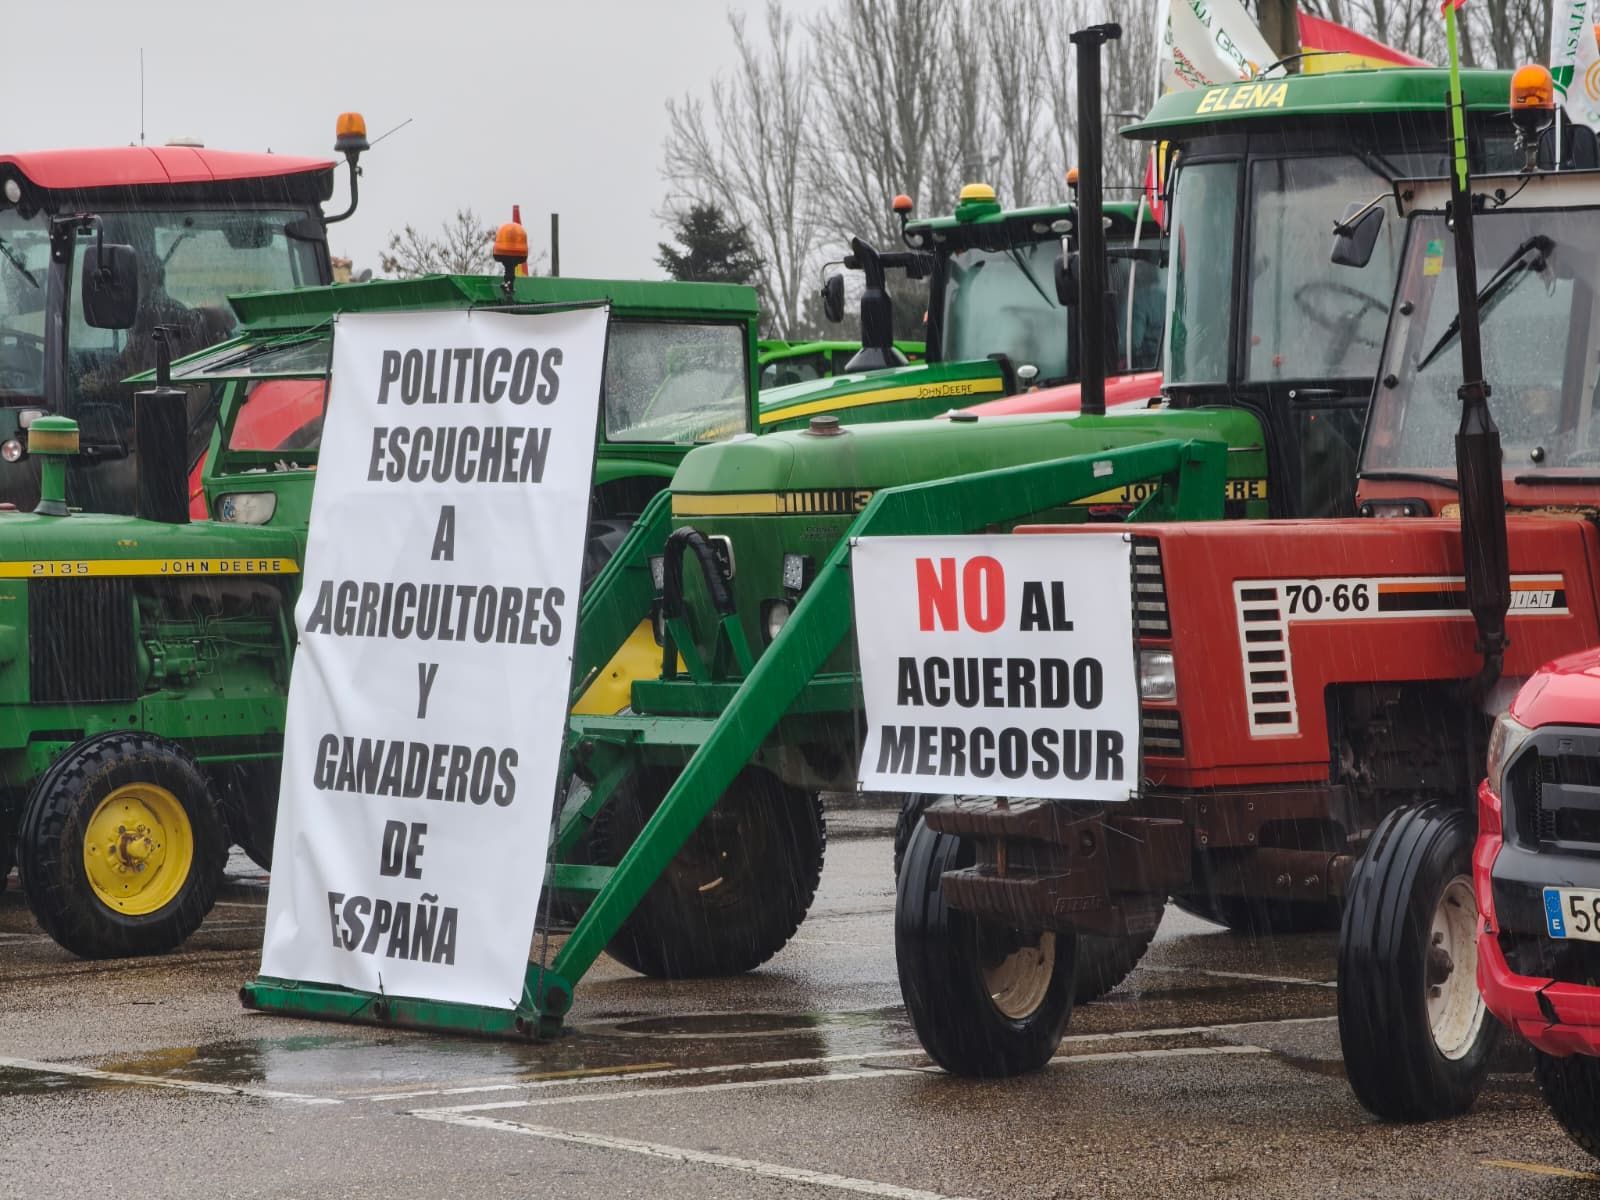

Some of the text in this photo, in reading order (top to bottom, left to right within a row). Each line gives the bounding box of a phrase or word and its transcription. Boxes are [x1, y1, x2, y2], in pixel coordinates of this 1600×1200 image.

[1565, 1, 1587, 61] ASAJA
[1195, 83, 1289, 114] ELENA
[378, 348, 563, 405] POLITICOS
[369, 426, 551, 483] ESCUCHEN
[430, 505, 455, 561] A
[32, 563, 89, 575] 2135
[161, 560, 281, 573] JOHN DEERE
[916, 556, 1074, 634] NO AL
[306, 580, 565, 646] AGRICULTORES
[1518, 593, 1553, 605] IAT
[417, 662, 439, 719] Y
[897, 656, 1104, 710] ACUERDO
[313, 733, 519, 807] GANADEROS
[876, 725, 1124, 781] MERCOSUR
[379, 820, 428, 880] DE
[327, 891, 458, 965] ESPAÑA
[1552, 918, 1561, 930] E
